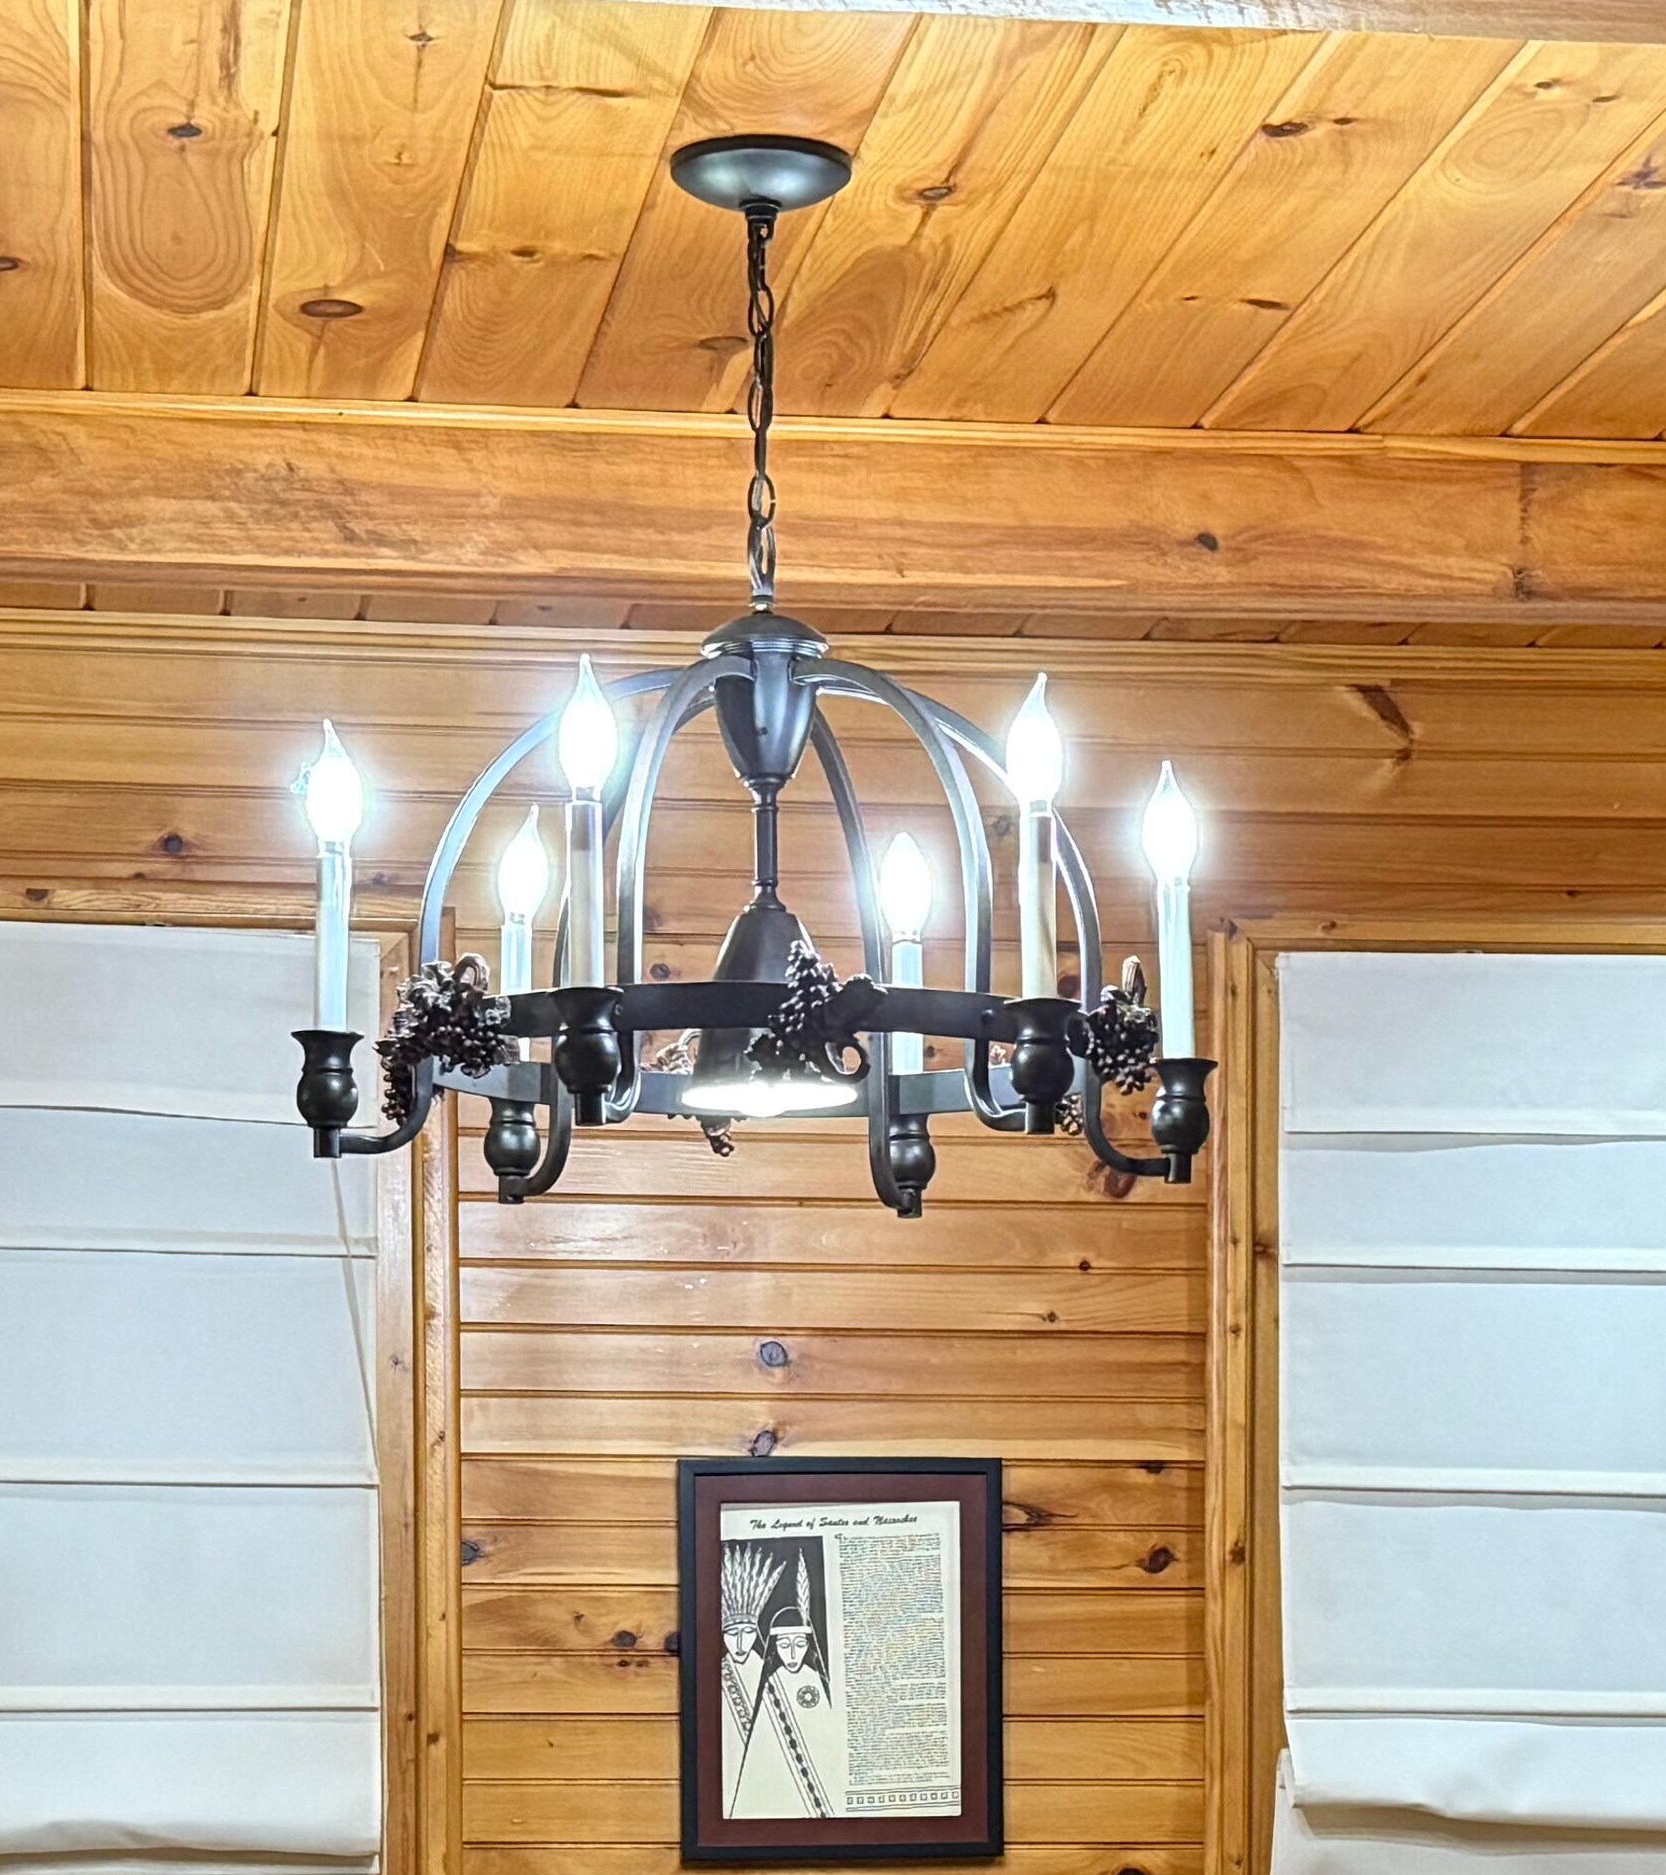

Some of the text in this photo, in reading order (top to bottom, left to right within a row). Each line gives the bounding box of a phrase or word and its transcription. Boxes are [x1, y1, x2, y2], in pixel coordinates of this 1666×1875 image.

[750, 1519, 766, 1530] The
[771, 1518, 803, 1531] Legend
[806, 1518, 815, 1530] of
[853, 1516, 870, 1526] and
